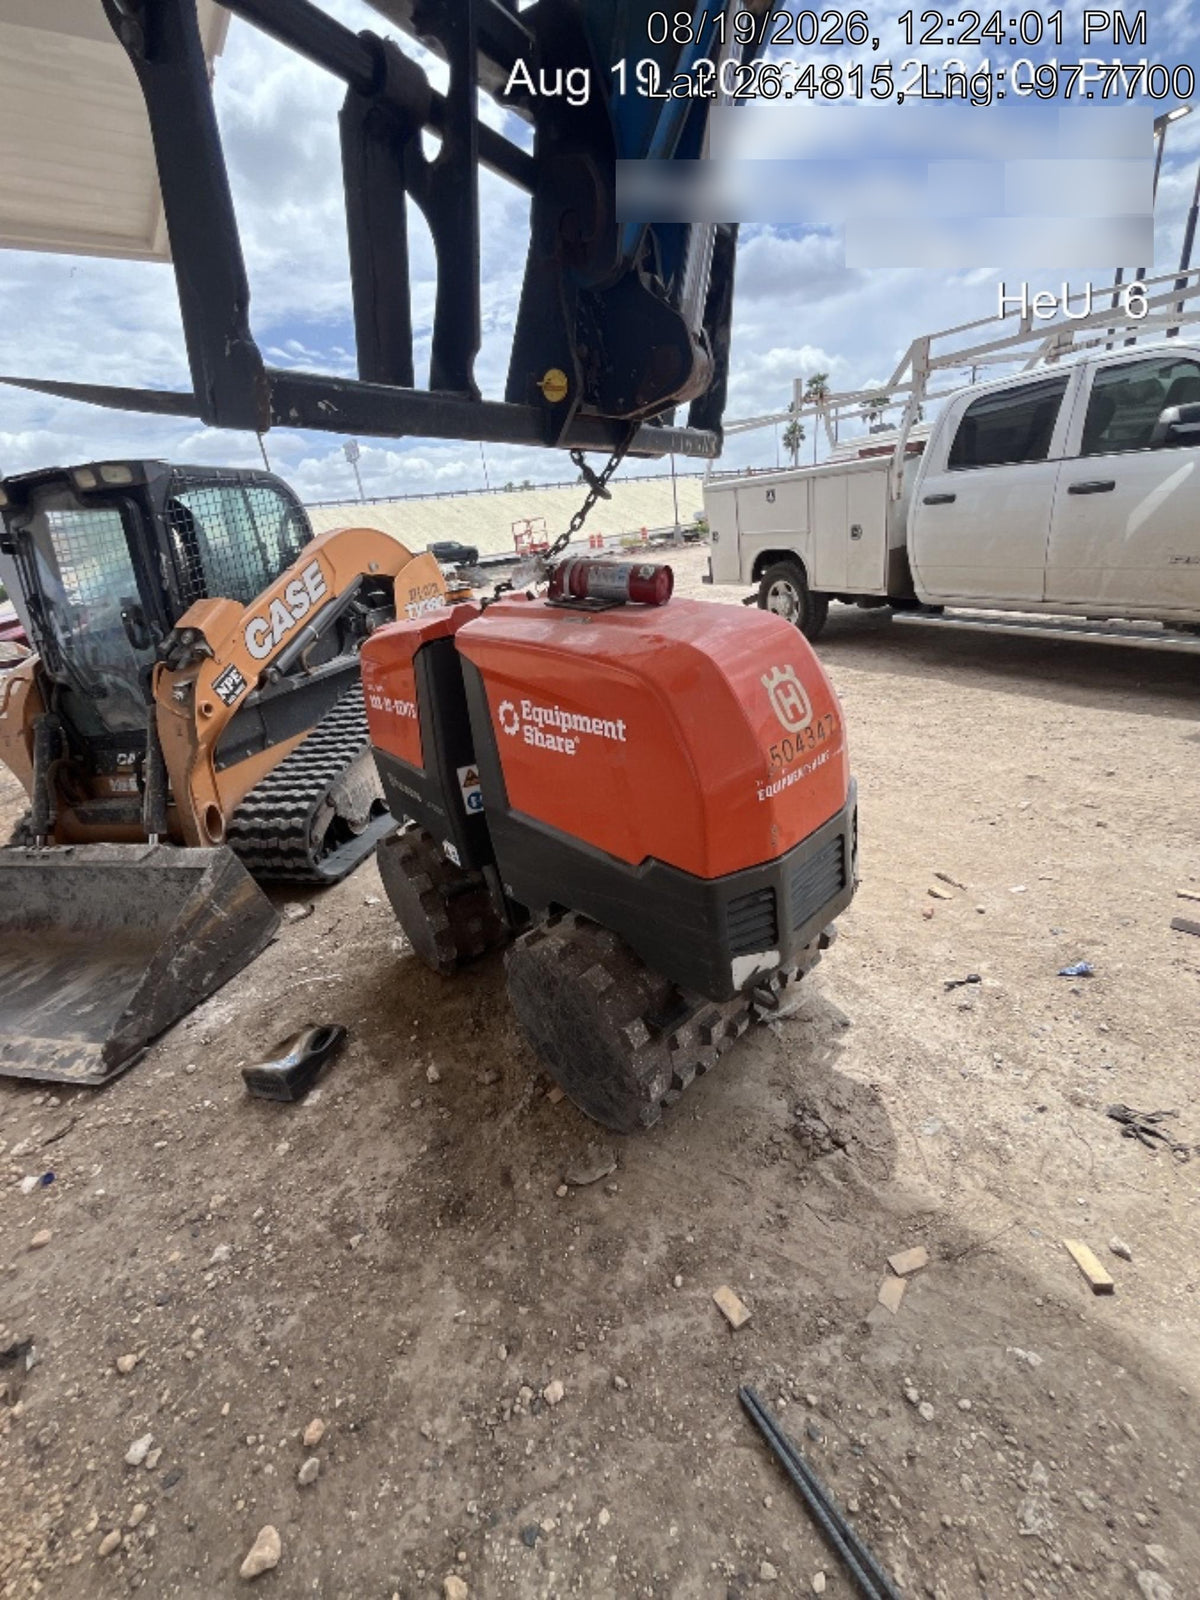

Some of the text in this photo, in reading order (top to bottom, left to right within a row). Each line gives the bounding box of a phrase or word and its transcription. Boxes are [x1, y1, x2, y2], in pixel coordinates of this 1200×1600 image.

[244, 558, 328, 660] CASE
[520, 700, 627, 742] Equipment
[768, 713, 834, 767] 504347
